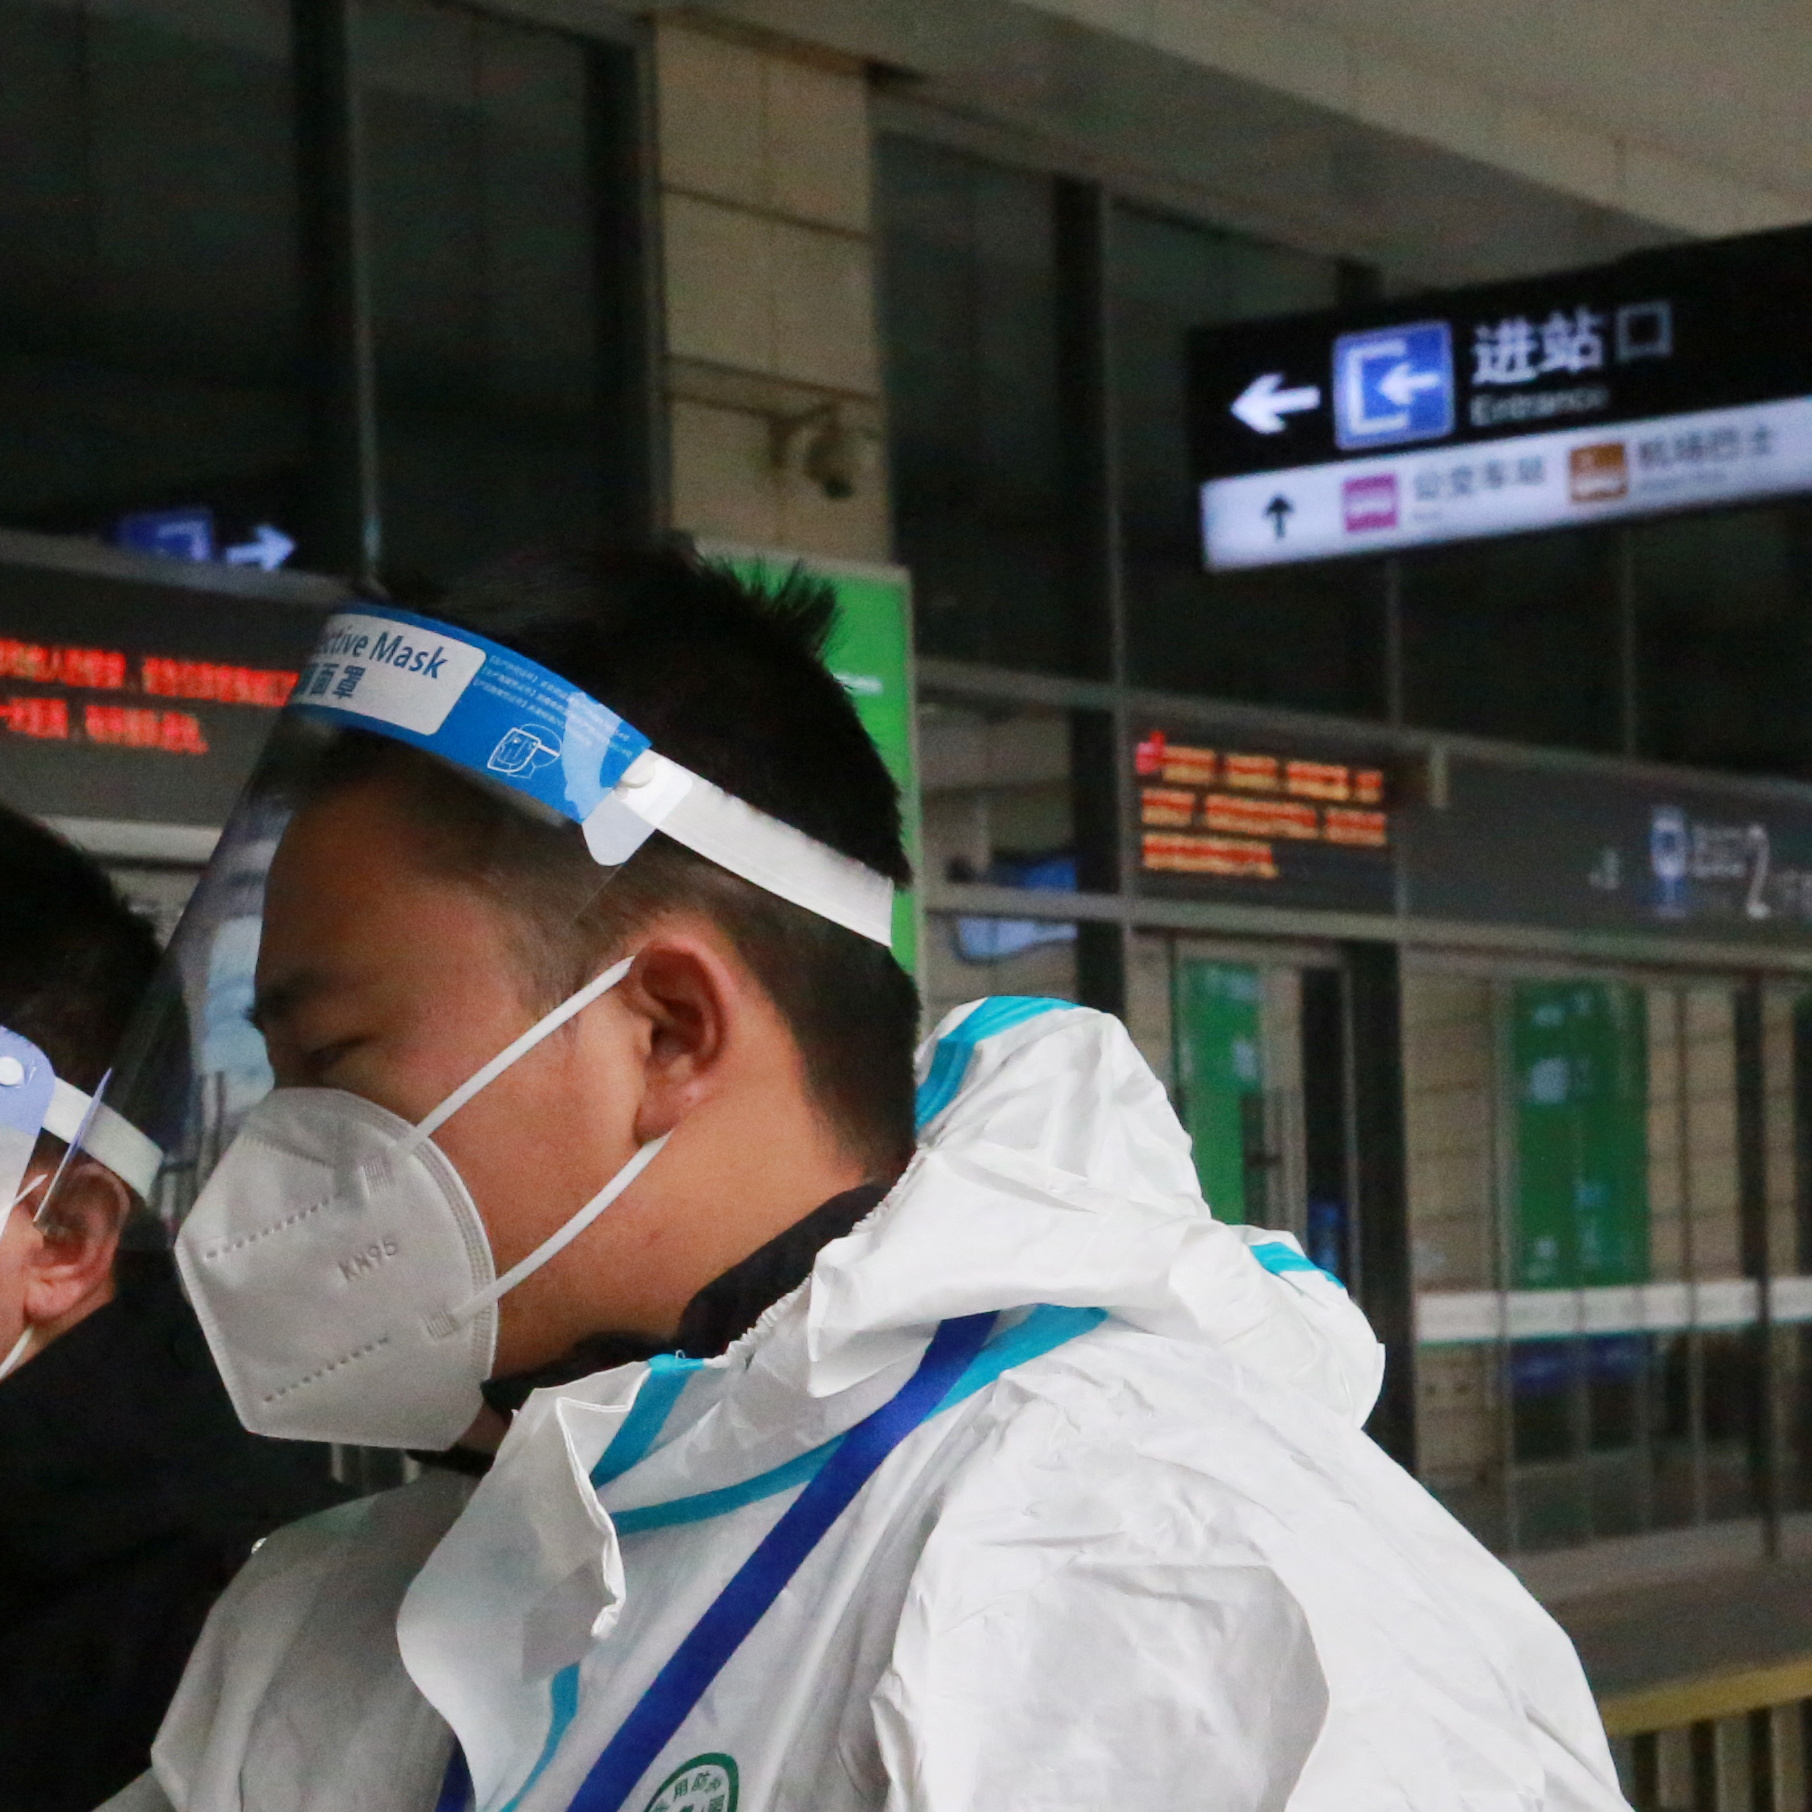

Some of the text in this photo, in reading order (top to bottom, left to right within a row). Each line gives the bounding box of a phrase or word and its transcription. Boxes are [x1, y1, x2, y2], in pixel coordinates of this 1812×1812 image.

[1471, 301, 1673, 385] 进站口
[369, 630, 449, 680] Mask
[338, 1240, 399, 1283] KN95
